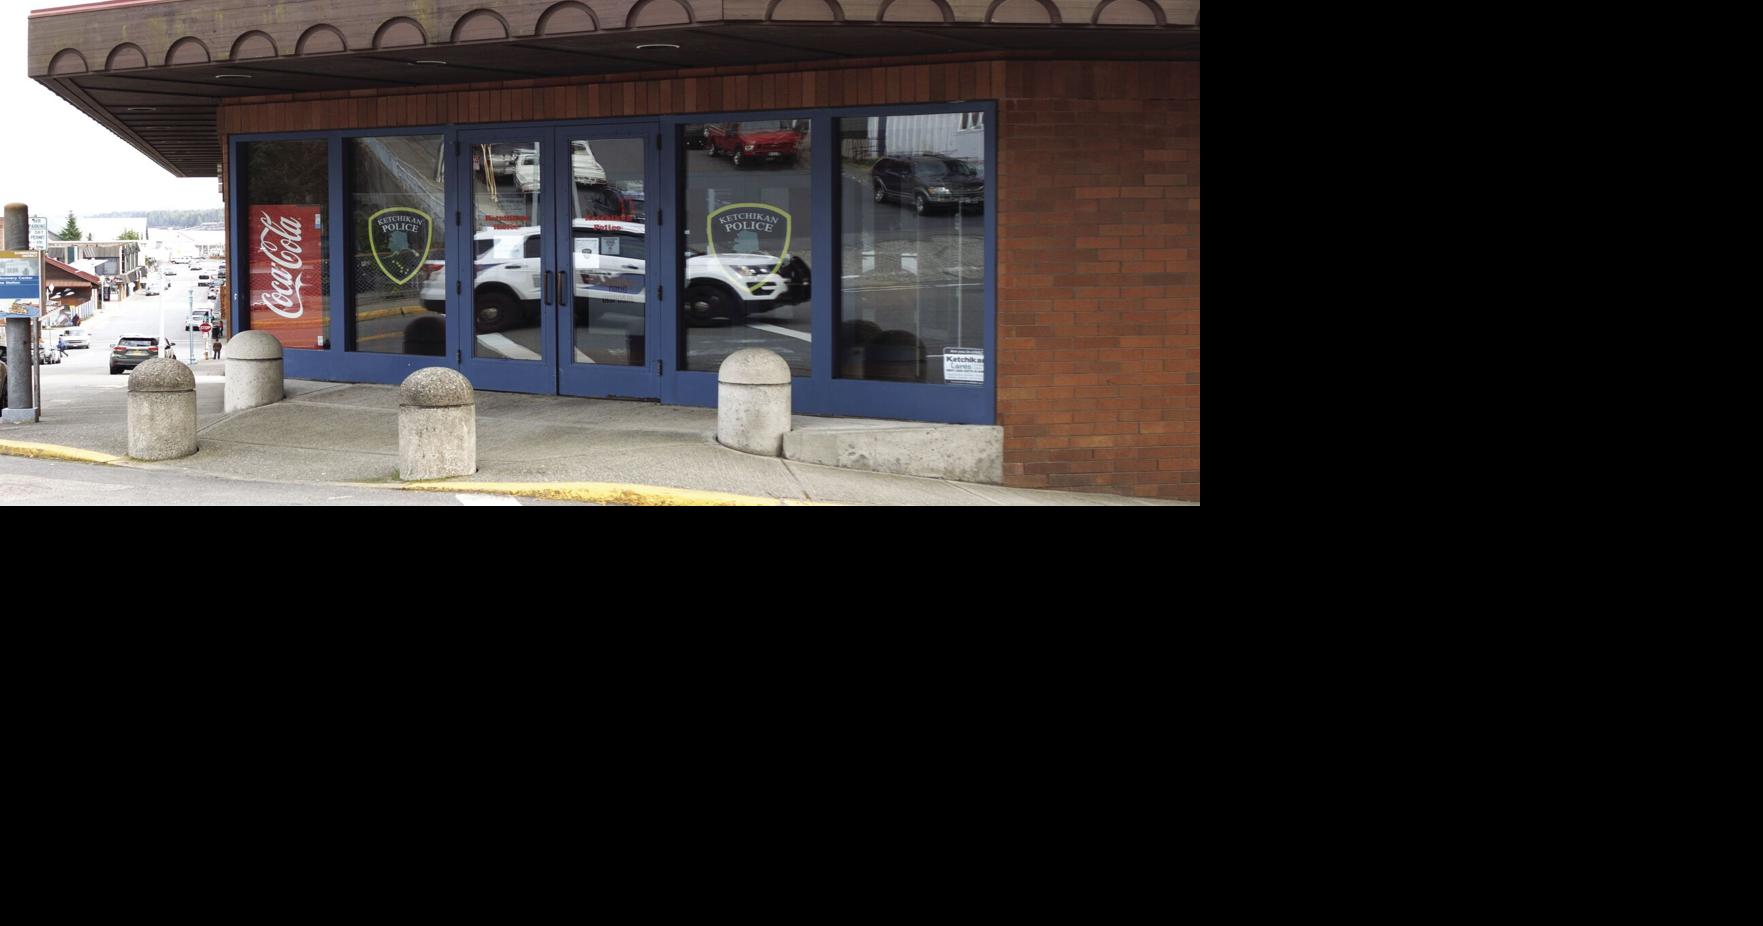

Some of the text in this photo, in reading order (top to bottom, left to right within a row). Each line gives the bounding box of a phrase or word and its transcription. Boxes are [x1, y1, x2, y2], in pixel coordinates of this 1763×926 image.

[377, 215, 423, 225] KETCHIKAN
[719, 212, 779, 224] KETCHIKAN
[382, 222, 419, 233] POLICE
[725, 221, 774, 233] POLICE
